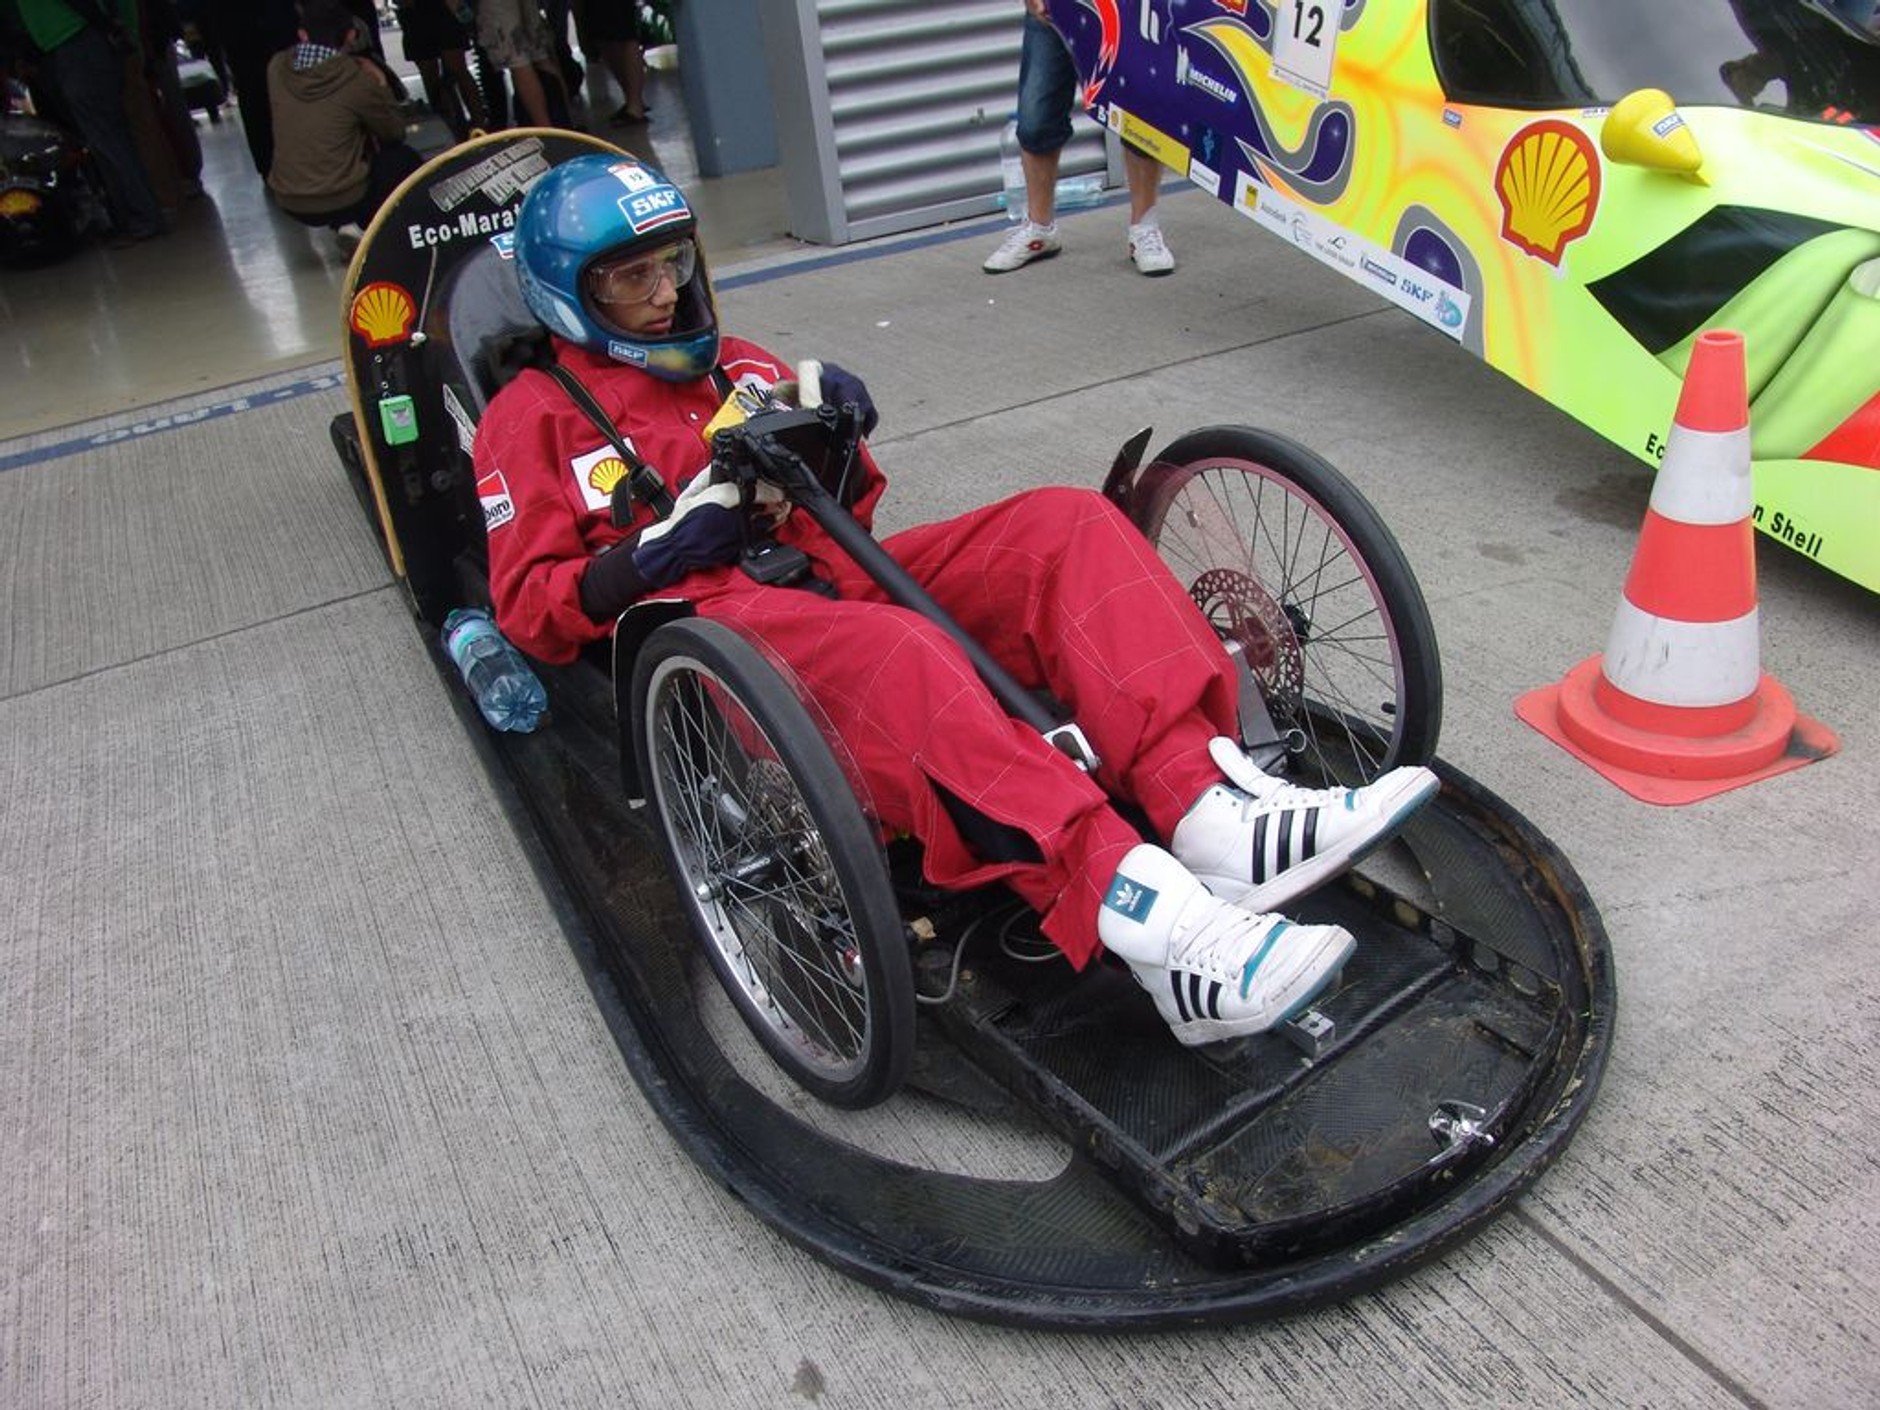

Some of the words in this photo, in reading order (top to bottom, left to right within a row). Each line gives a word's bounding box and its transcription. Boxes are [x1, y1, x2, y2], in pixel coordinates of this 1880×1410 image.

[1293, 0, 1324, 48] 12
[408, 203, 519, 249] Eco-Marat
[631, 190, 677, 217] SKF
[1400, 278, 1434, 303] SKF
[1770, 511, 1823, 558] Shell
